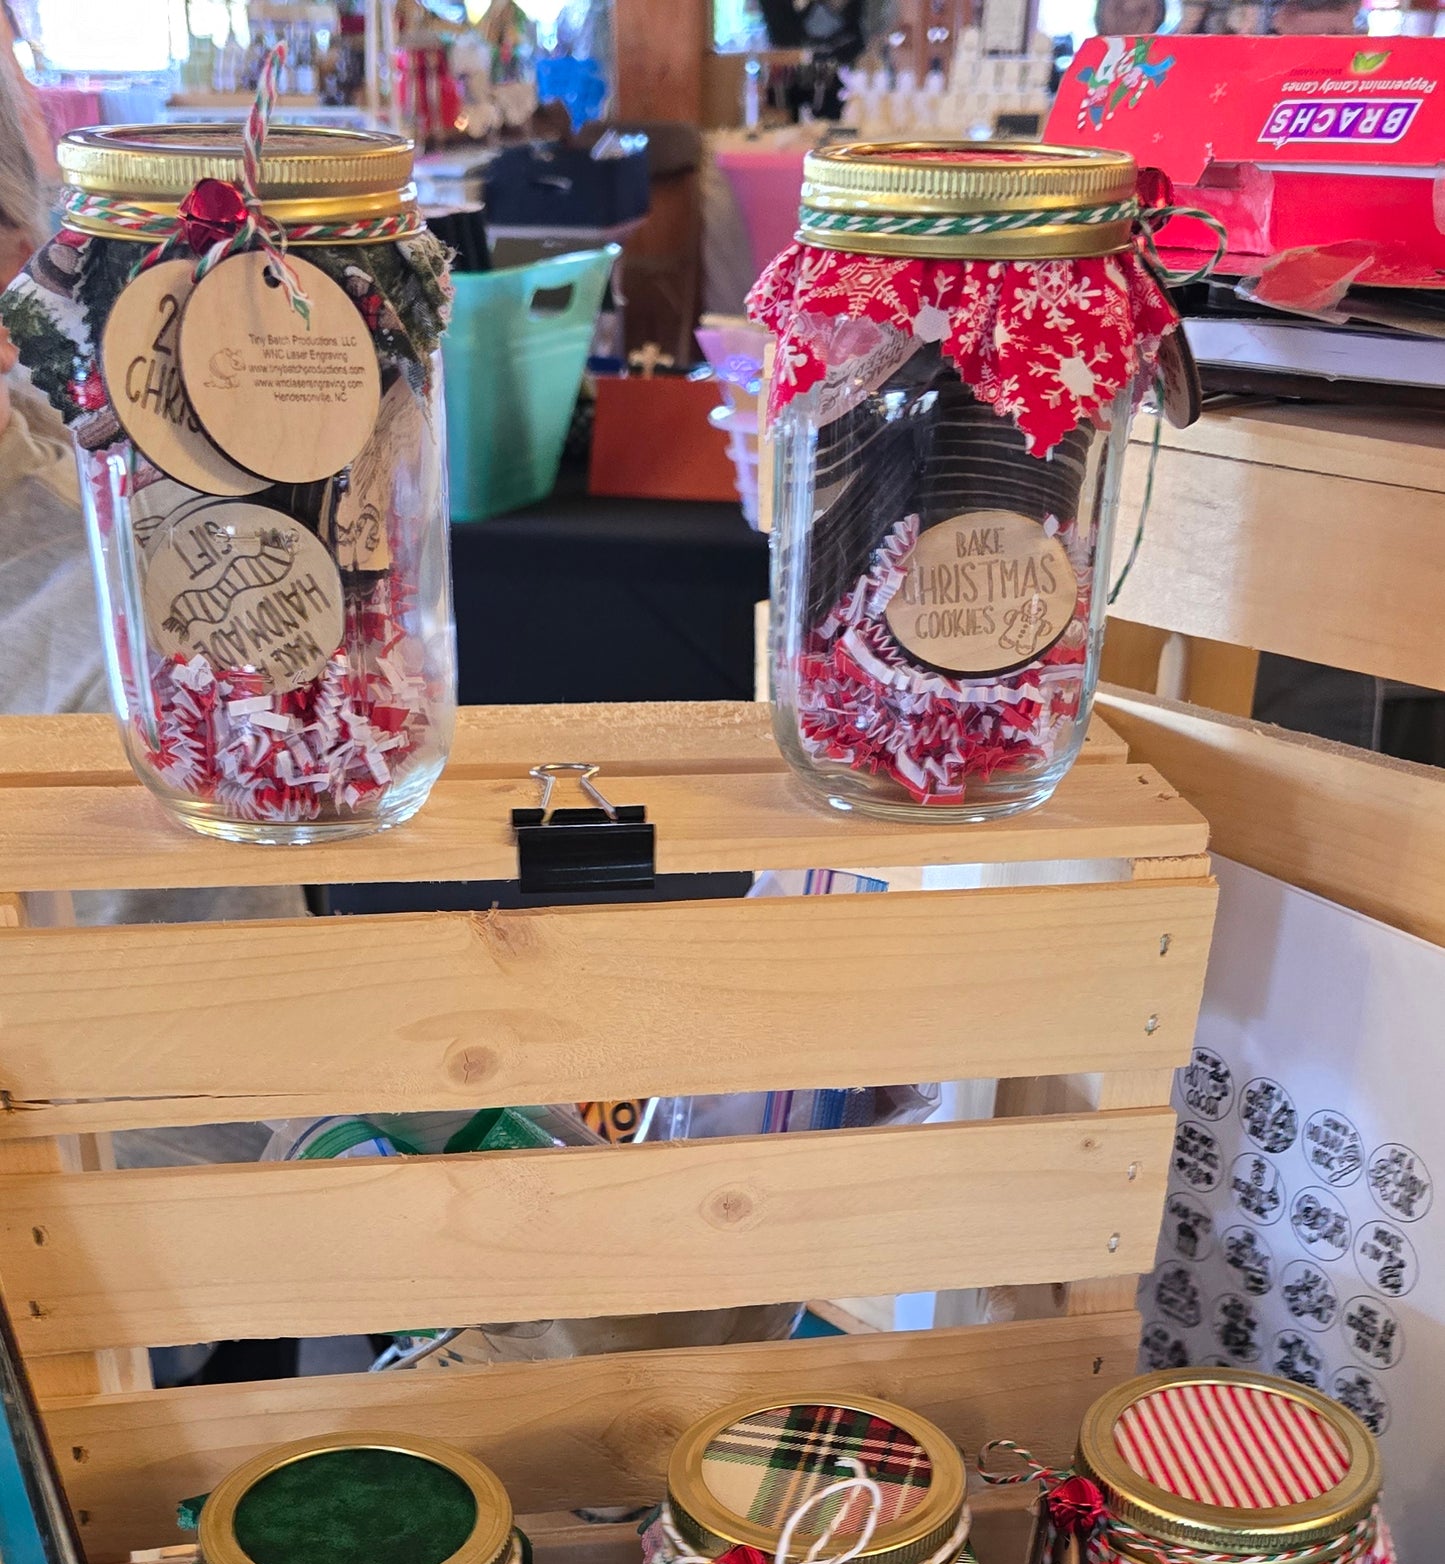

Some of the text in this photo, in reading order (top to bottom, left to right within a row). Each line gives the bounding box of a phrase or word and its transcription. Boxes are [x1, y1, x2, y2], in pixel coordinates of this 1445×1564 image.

[1281, 77, 1437, 94] Peppermint Candy Canes
[248, 333, 266, 347] Tiny
[341, 336, 358, 347] LLC
[262, 349, 348, 363] WNC Laser Engraving
[335, 392, 348, 402] NC
[173, 520, 233, 581] GIFT
[955, 527, 1005, 558] BAKE
[902, 552, 1057, 606] CHRISTMAS
[914, 605, 996, 640] COOKIES
[270, 630, 325, 678] MAKE
